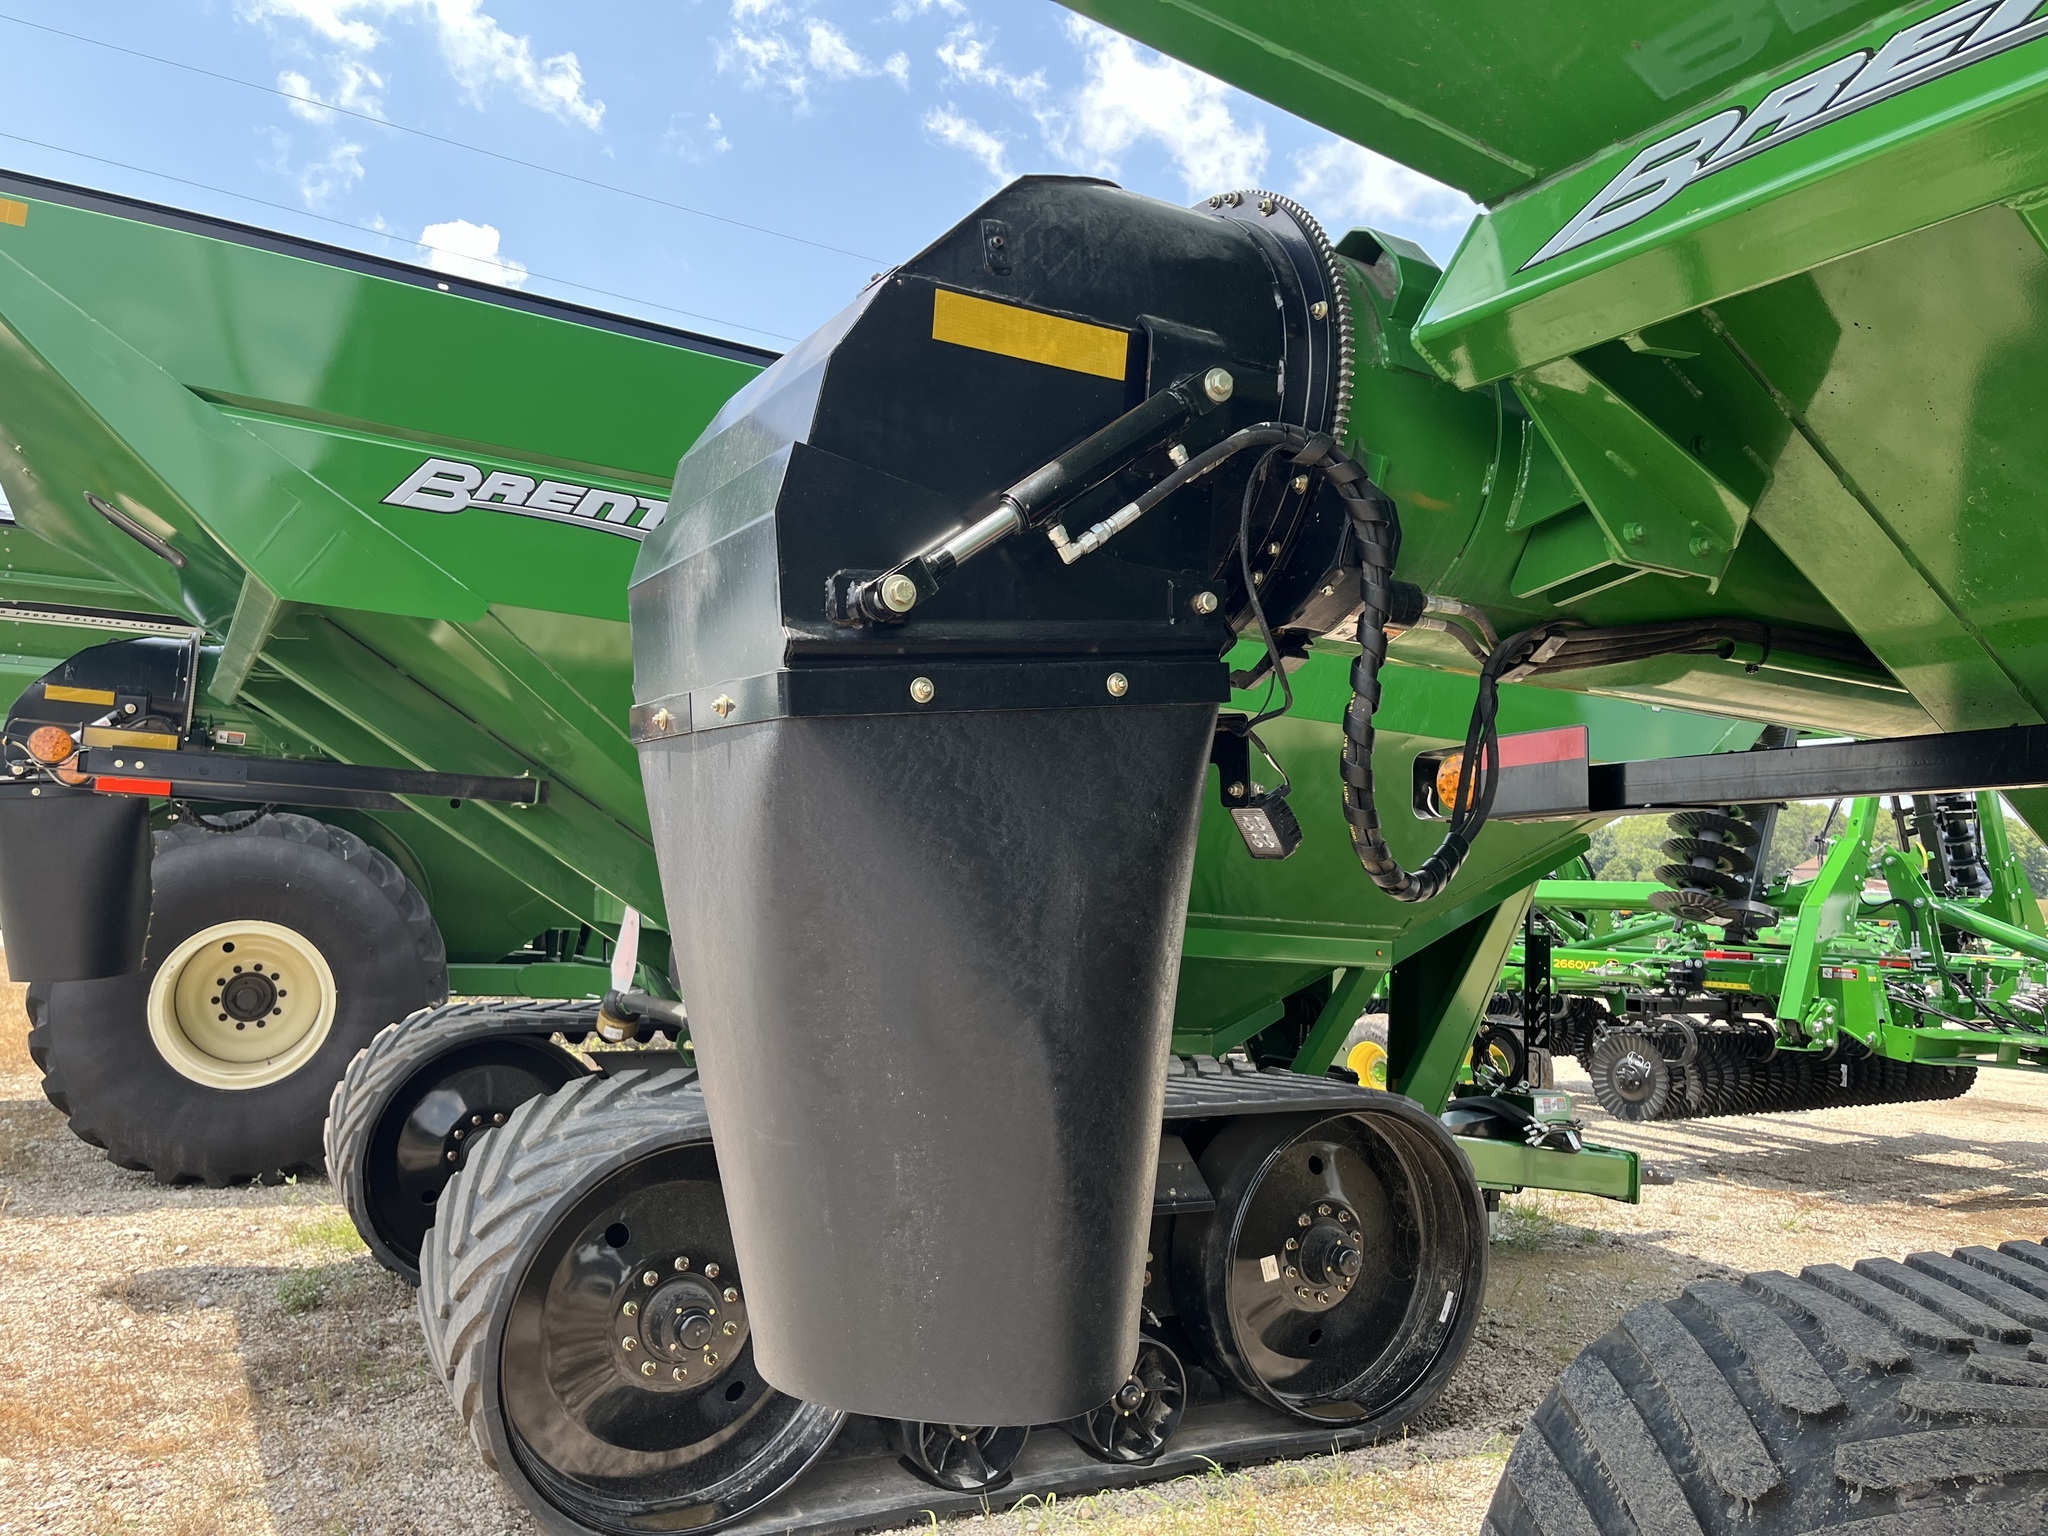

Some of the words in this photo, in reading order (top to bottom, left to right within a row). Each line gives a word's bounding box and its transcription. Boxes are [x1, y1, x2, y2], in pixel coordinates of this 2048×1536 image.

[379, 457, 670, 534] BRENT
[16, 611, 56, 619] FRONT
[66, 616, 121, 625] FOLDING
[1553, 958, 1598, 970] 2660VT
